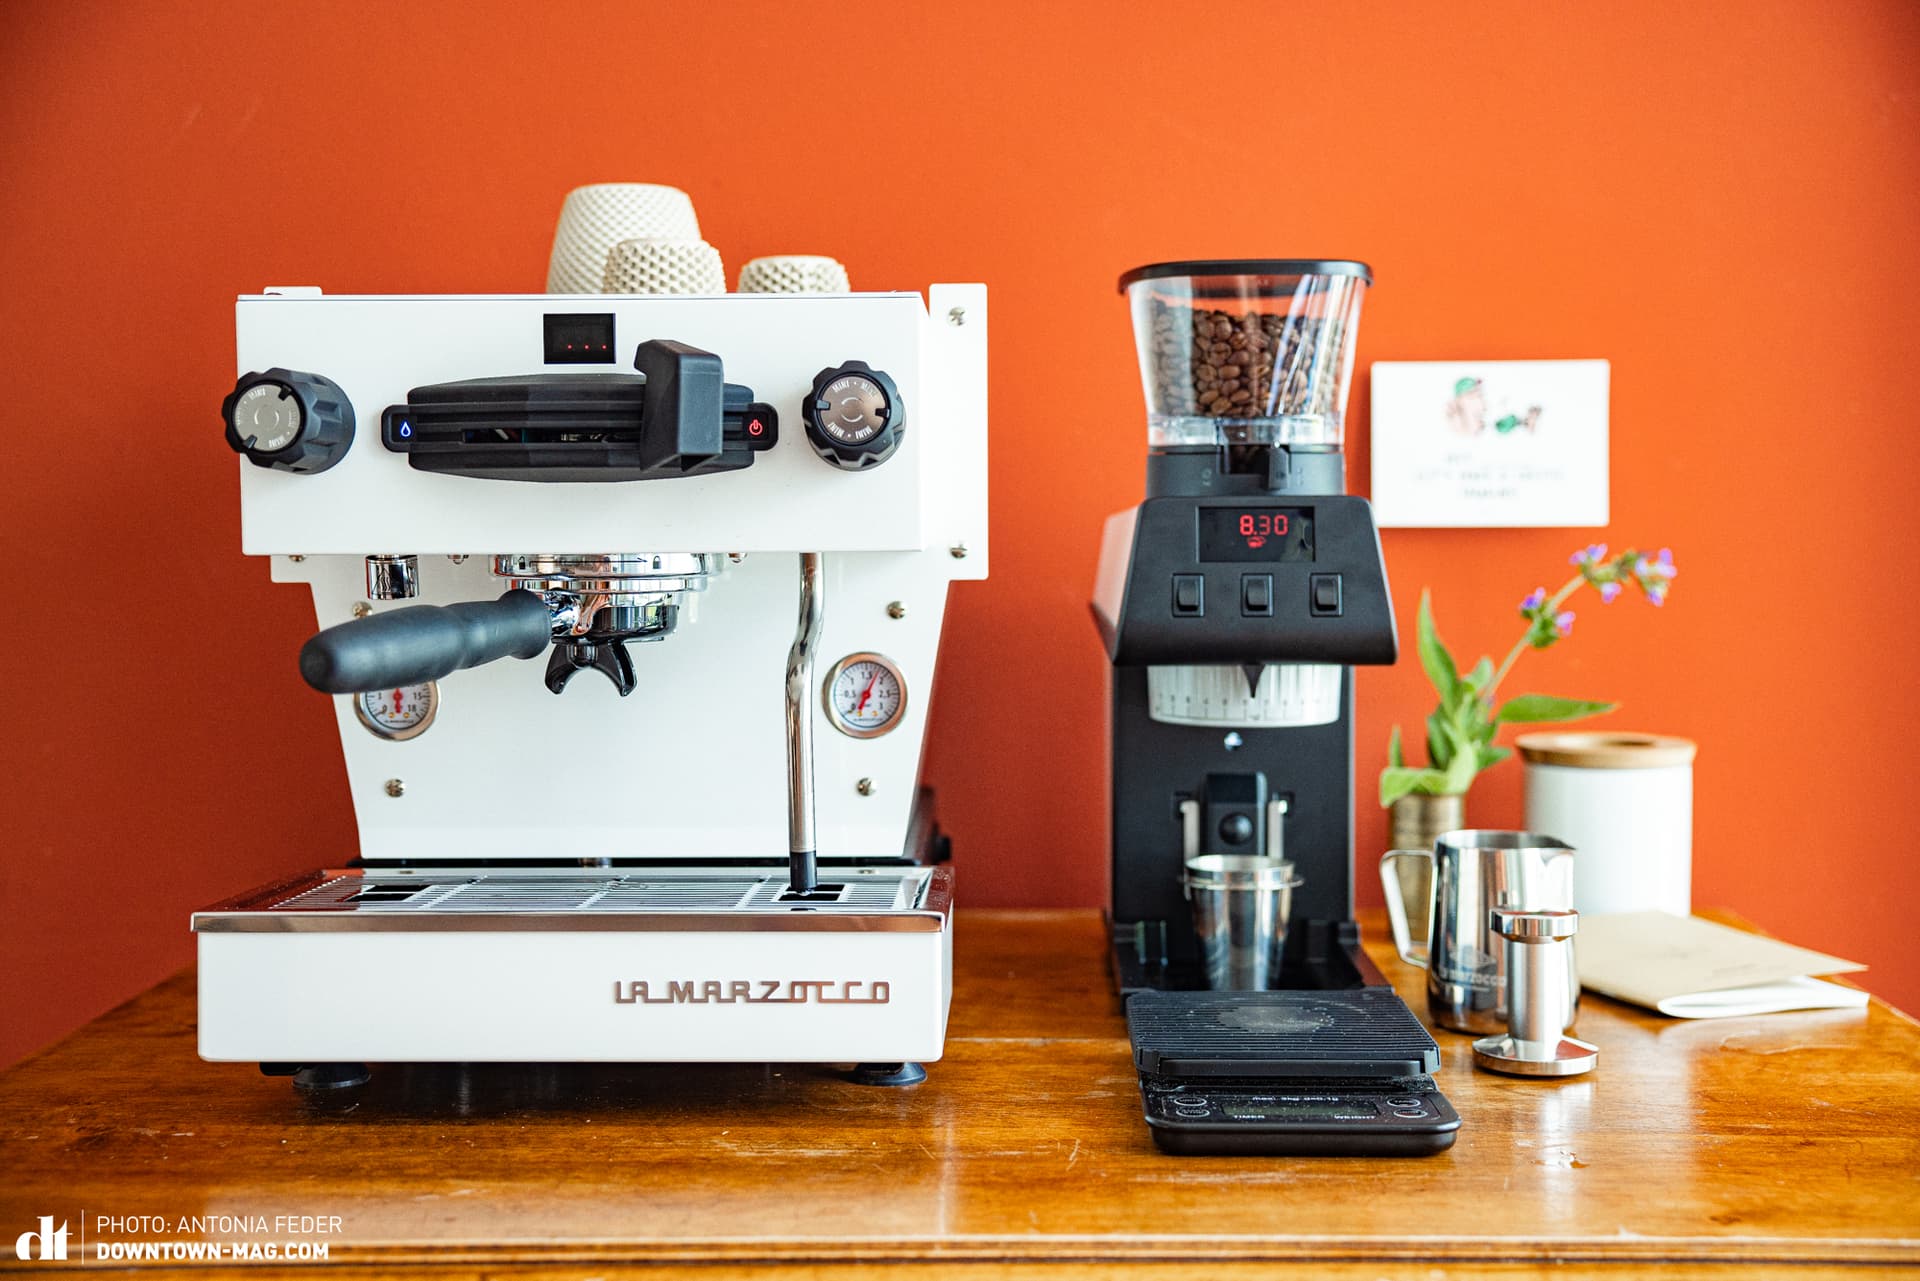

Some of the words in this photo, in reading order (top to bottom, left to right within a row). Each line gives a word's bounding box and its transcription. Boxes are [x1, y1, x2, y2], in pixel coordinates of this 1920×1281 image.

[1239, 514, 1289, 536] 8.30
[616, 980, 649, 1003] LA
[668, 980, 889, 1003] MARZOCCO
